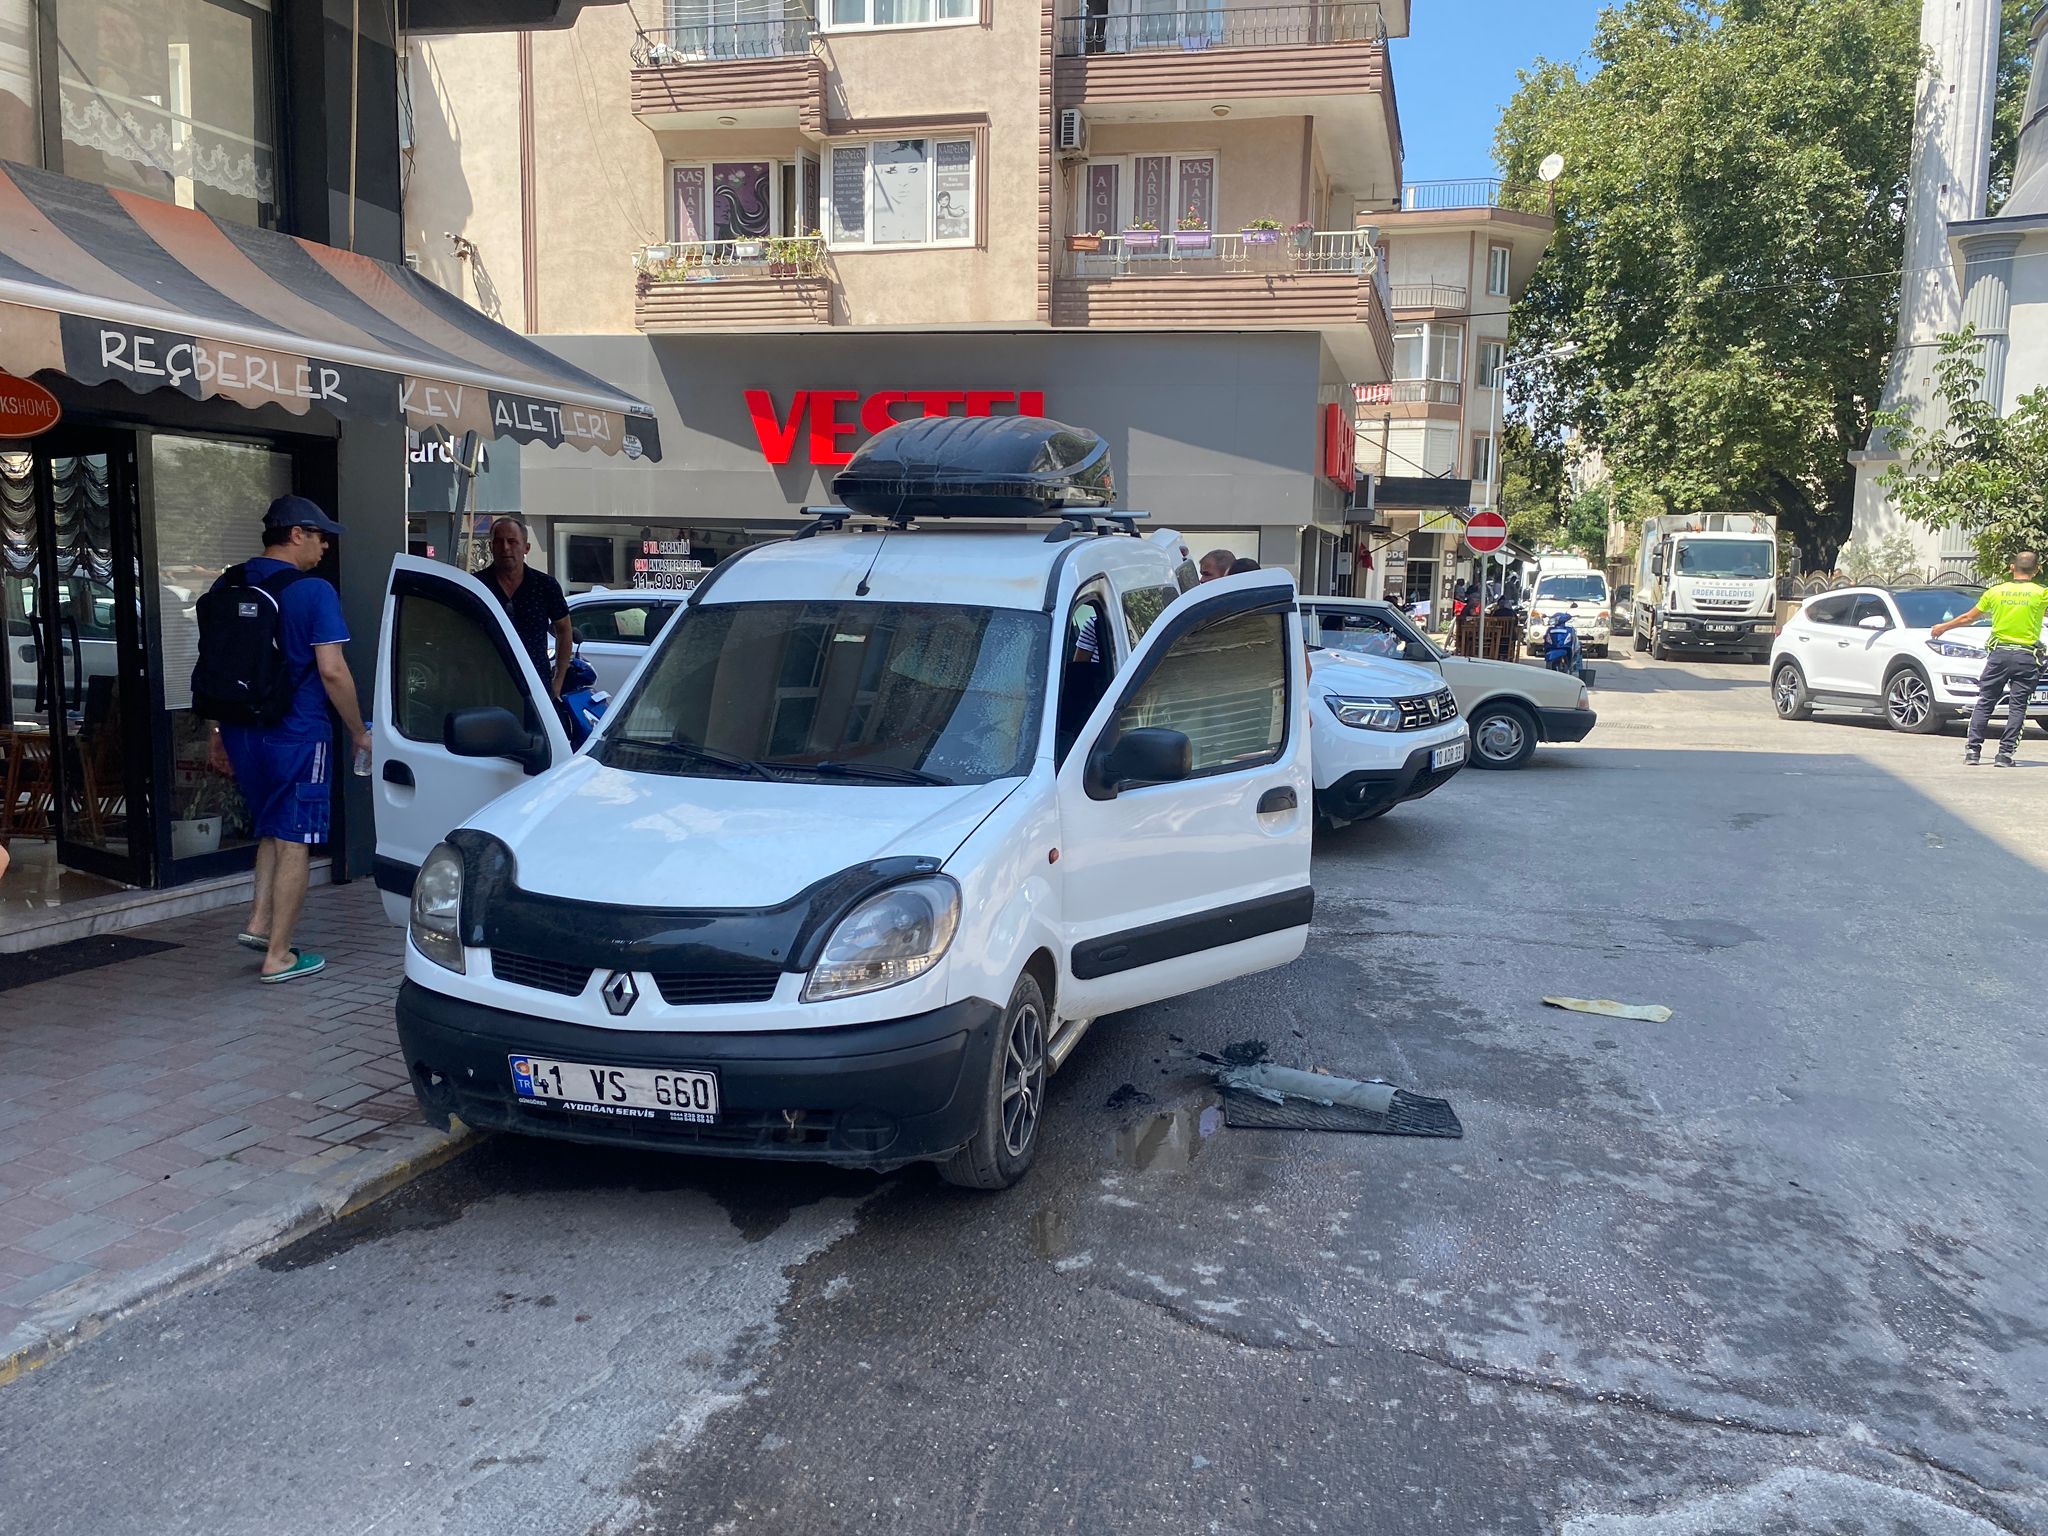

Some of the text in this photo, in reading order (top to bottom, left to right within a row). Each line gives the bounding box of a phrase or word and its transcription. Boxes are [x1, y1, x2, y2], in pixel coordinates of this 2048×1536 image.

[1182, 161, 1211, 176] KAŞ
[677, 170, 703, 185] KAŞ
[100, 329, 348, 403] REÇBERLER
[495, 399, 611, 441] ALETLERİ
[633, 572, 684, 590] 11.999
[1692, 588, 1714, 596] ERDEK
[518, 1080, 531, 1089] TR
[533, 1063, 709, 1110] 41 VS 660
[563, 1102, 655, 1118] AYDOĞAN SERVİS
